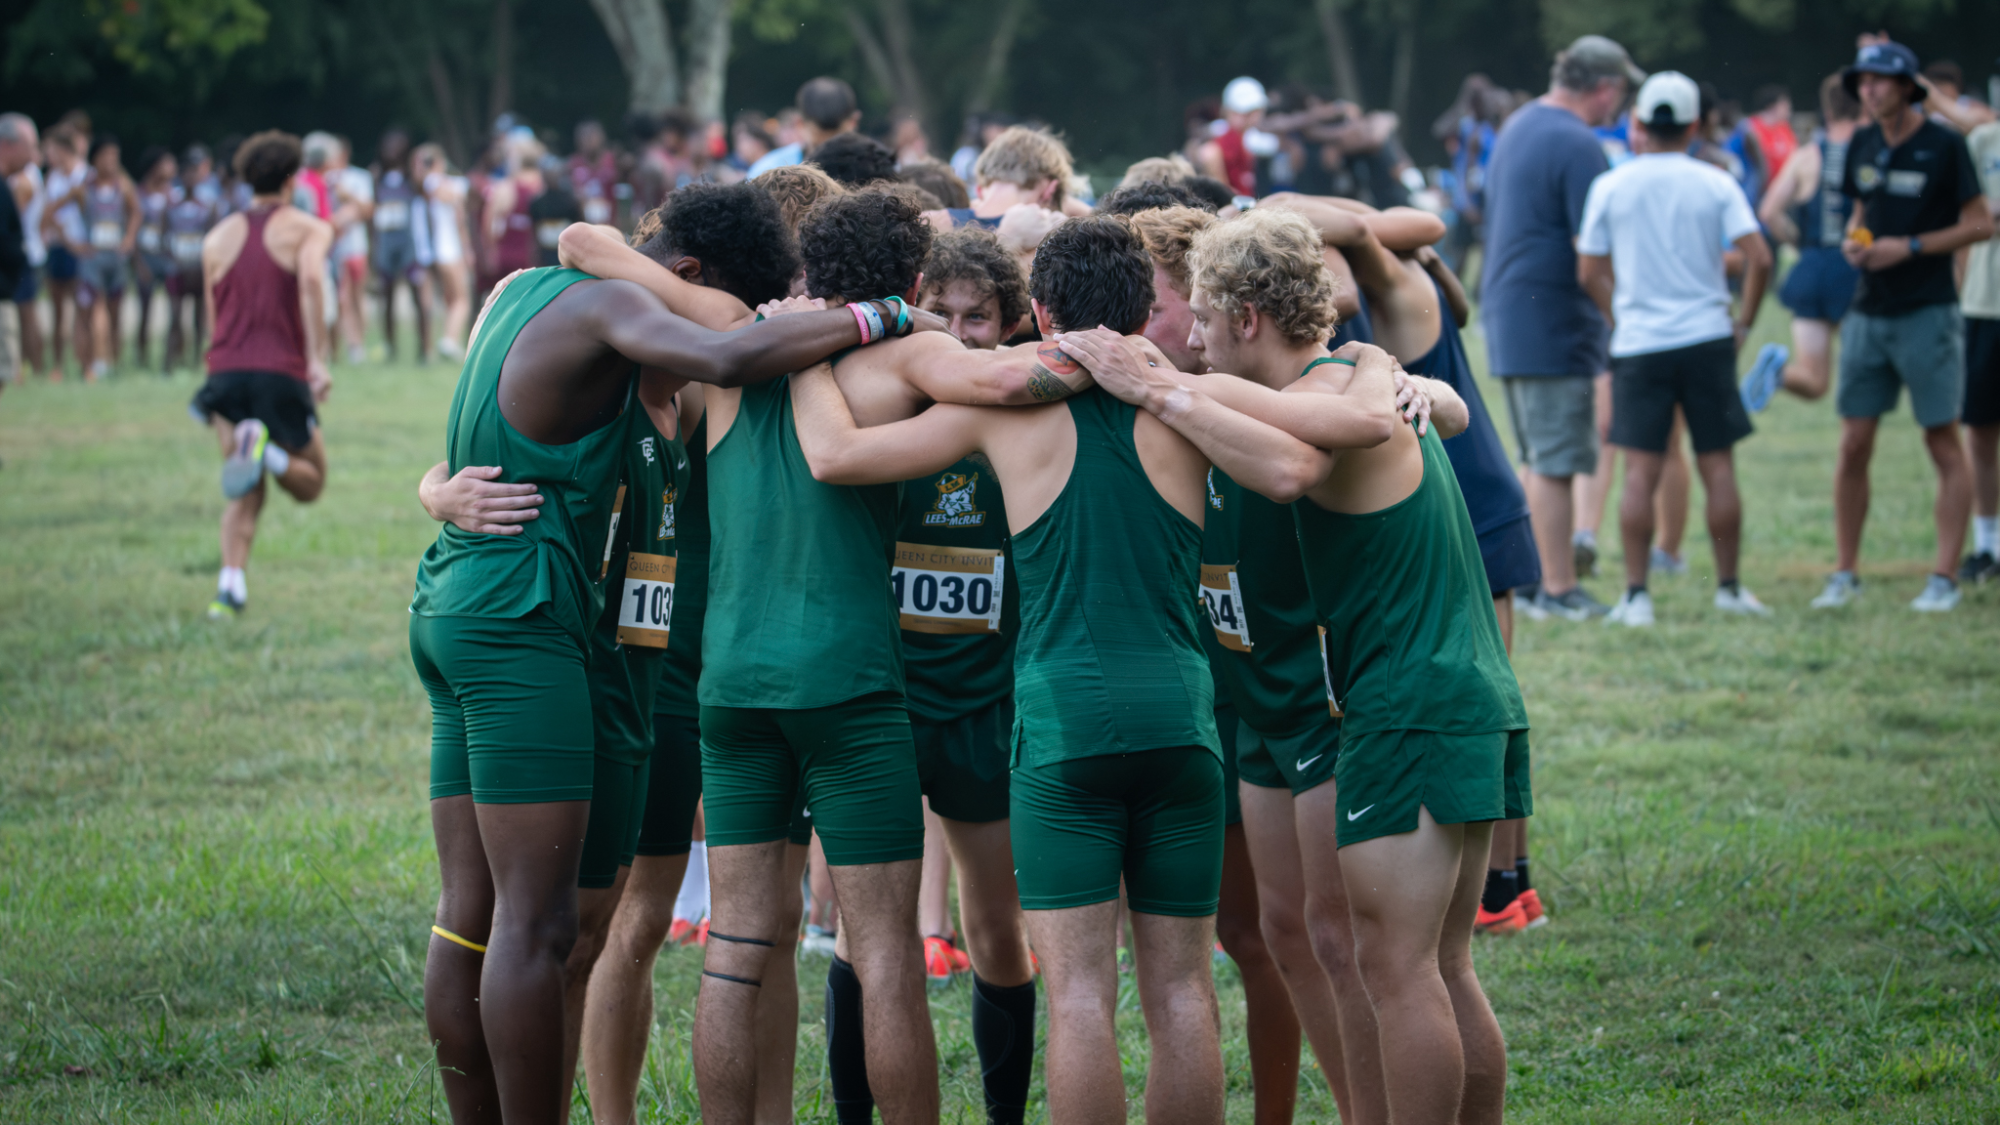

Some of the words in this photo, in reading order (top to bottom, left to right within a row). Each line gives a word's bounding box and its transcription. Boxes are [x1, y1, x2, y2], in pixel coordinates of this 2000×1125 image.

[930, 554, 956, 565] CITY
[629, 561, 660, 573] QUEEN
[891, 570, 993, 616] 1030
